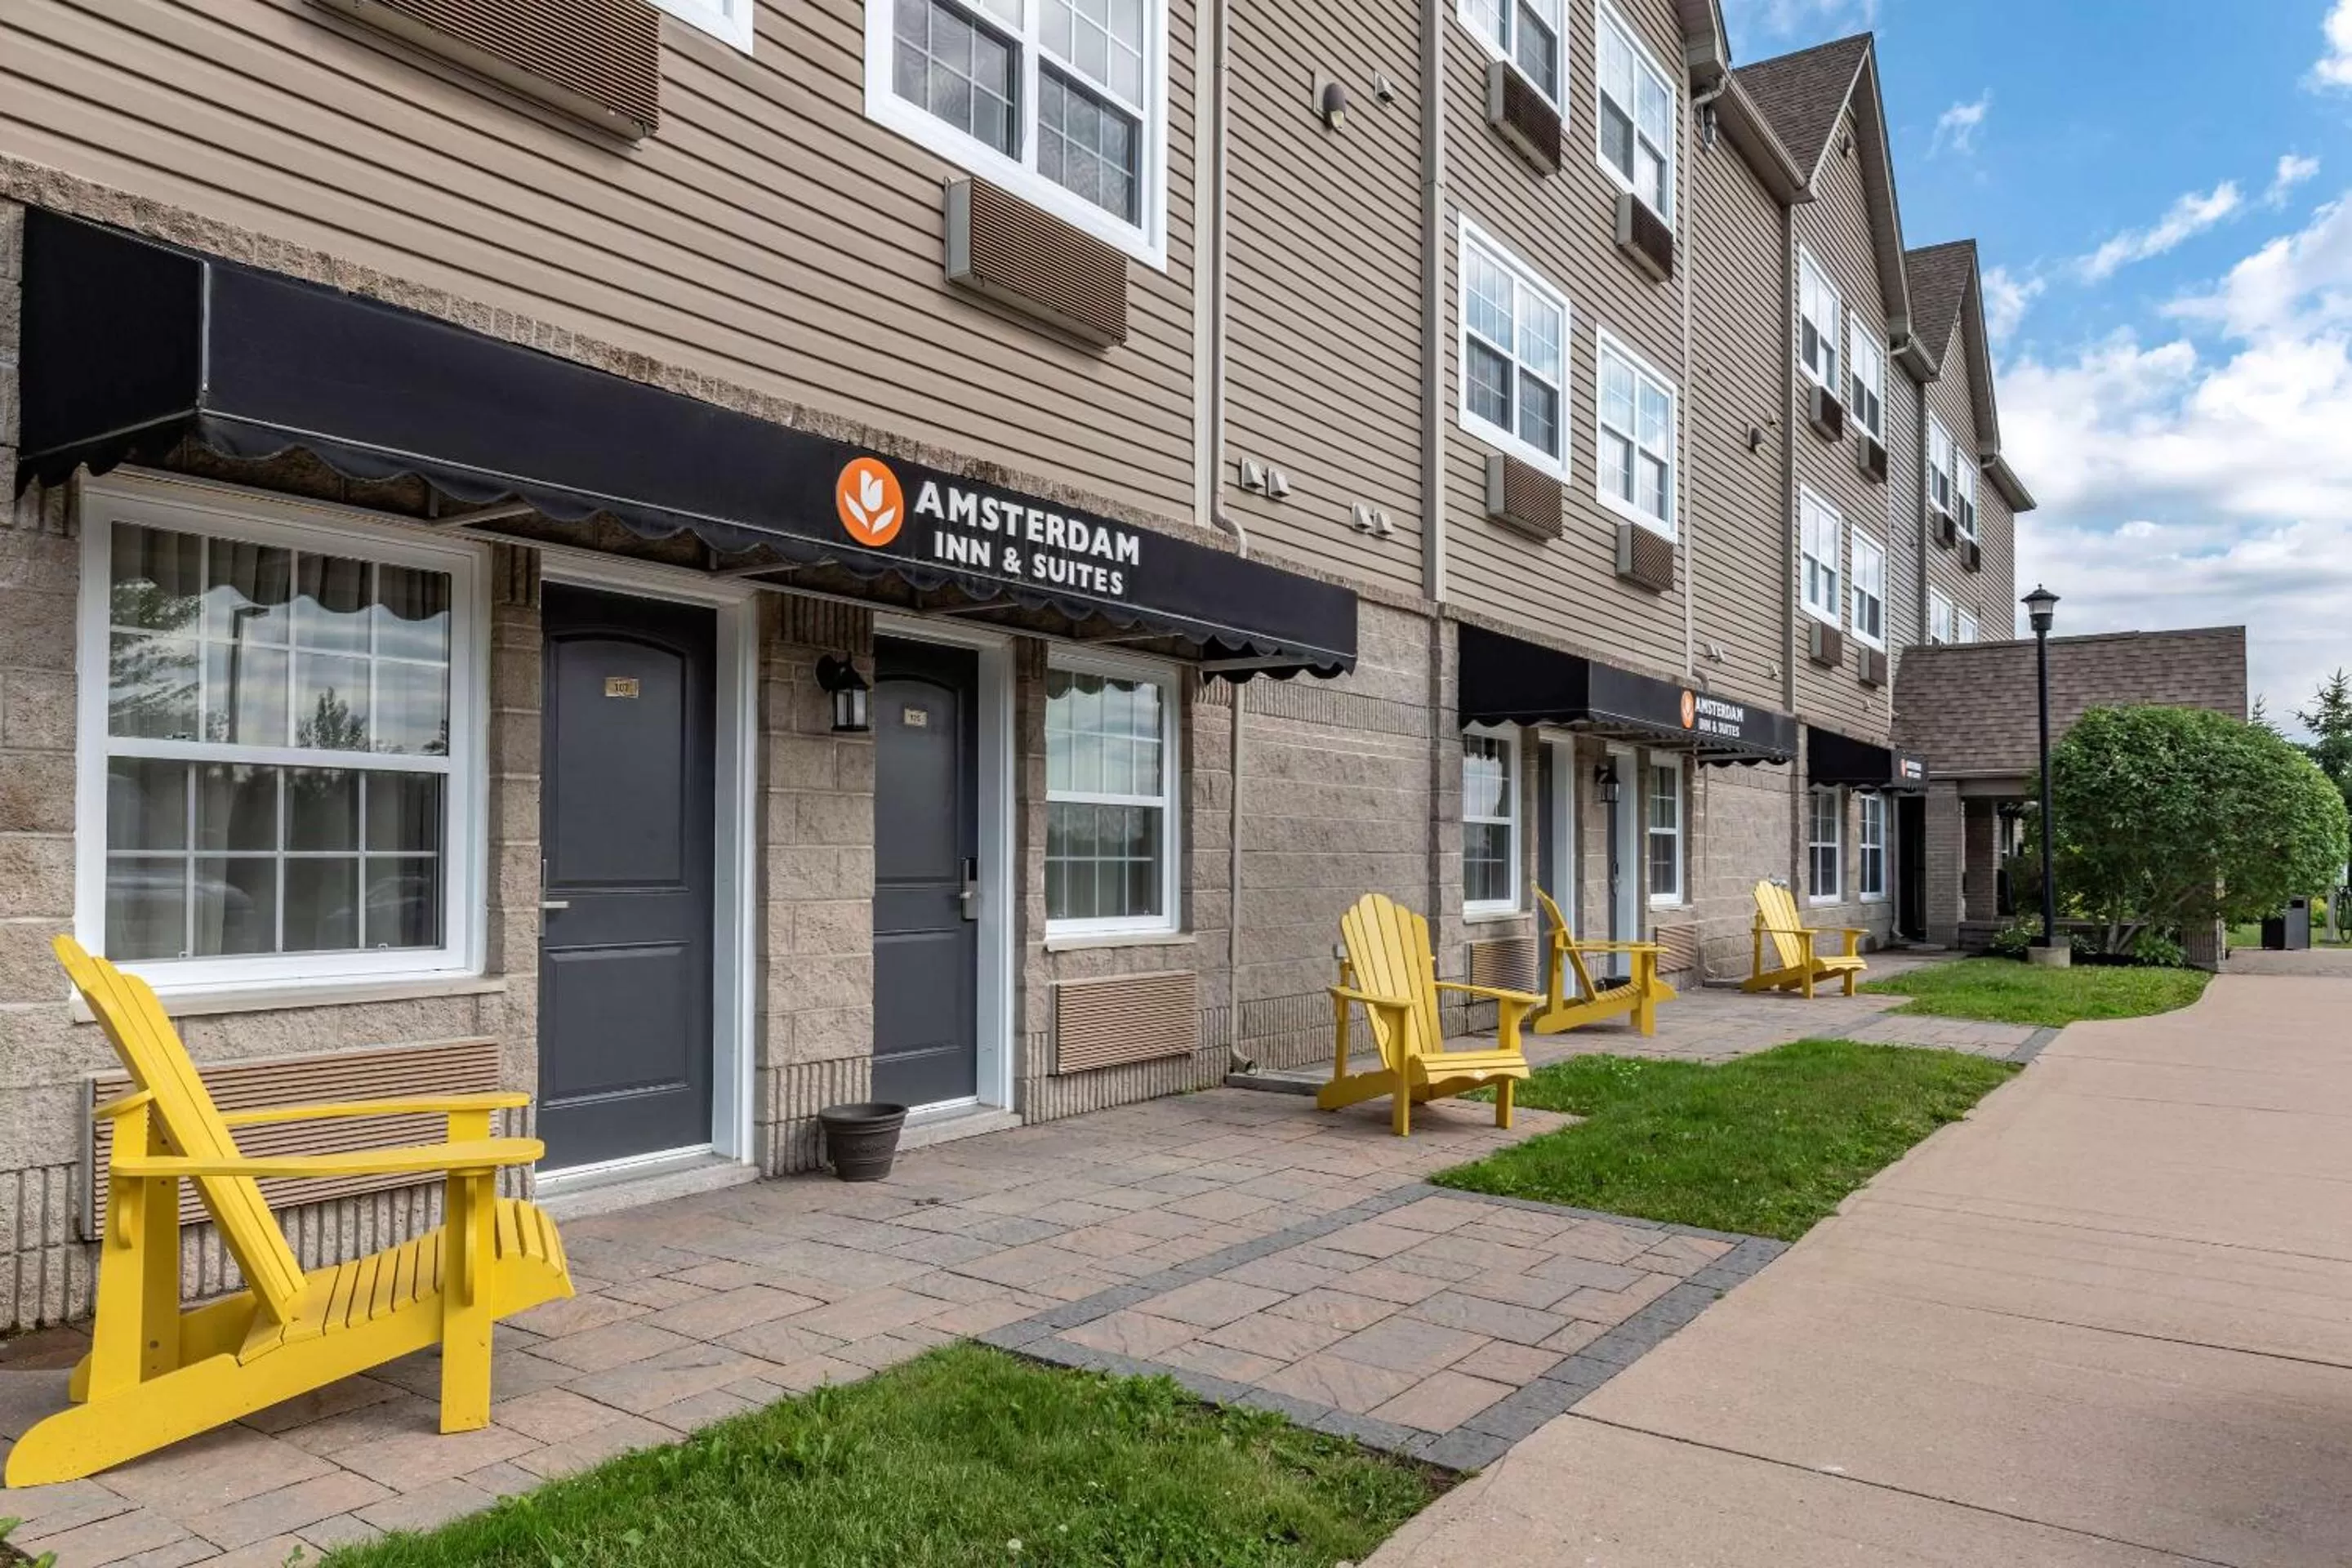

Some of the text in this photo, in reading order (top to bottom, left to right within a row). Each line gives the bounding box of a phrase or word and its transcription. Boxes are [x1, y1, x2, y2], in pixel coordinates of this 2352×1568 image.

[915, 481, 1139, 565] AMSTERDAM
[935, 532, 1123, 595] INN & SUITES
[1695, 697, 1744, 722] AMSTERDAM
